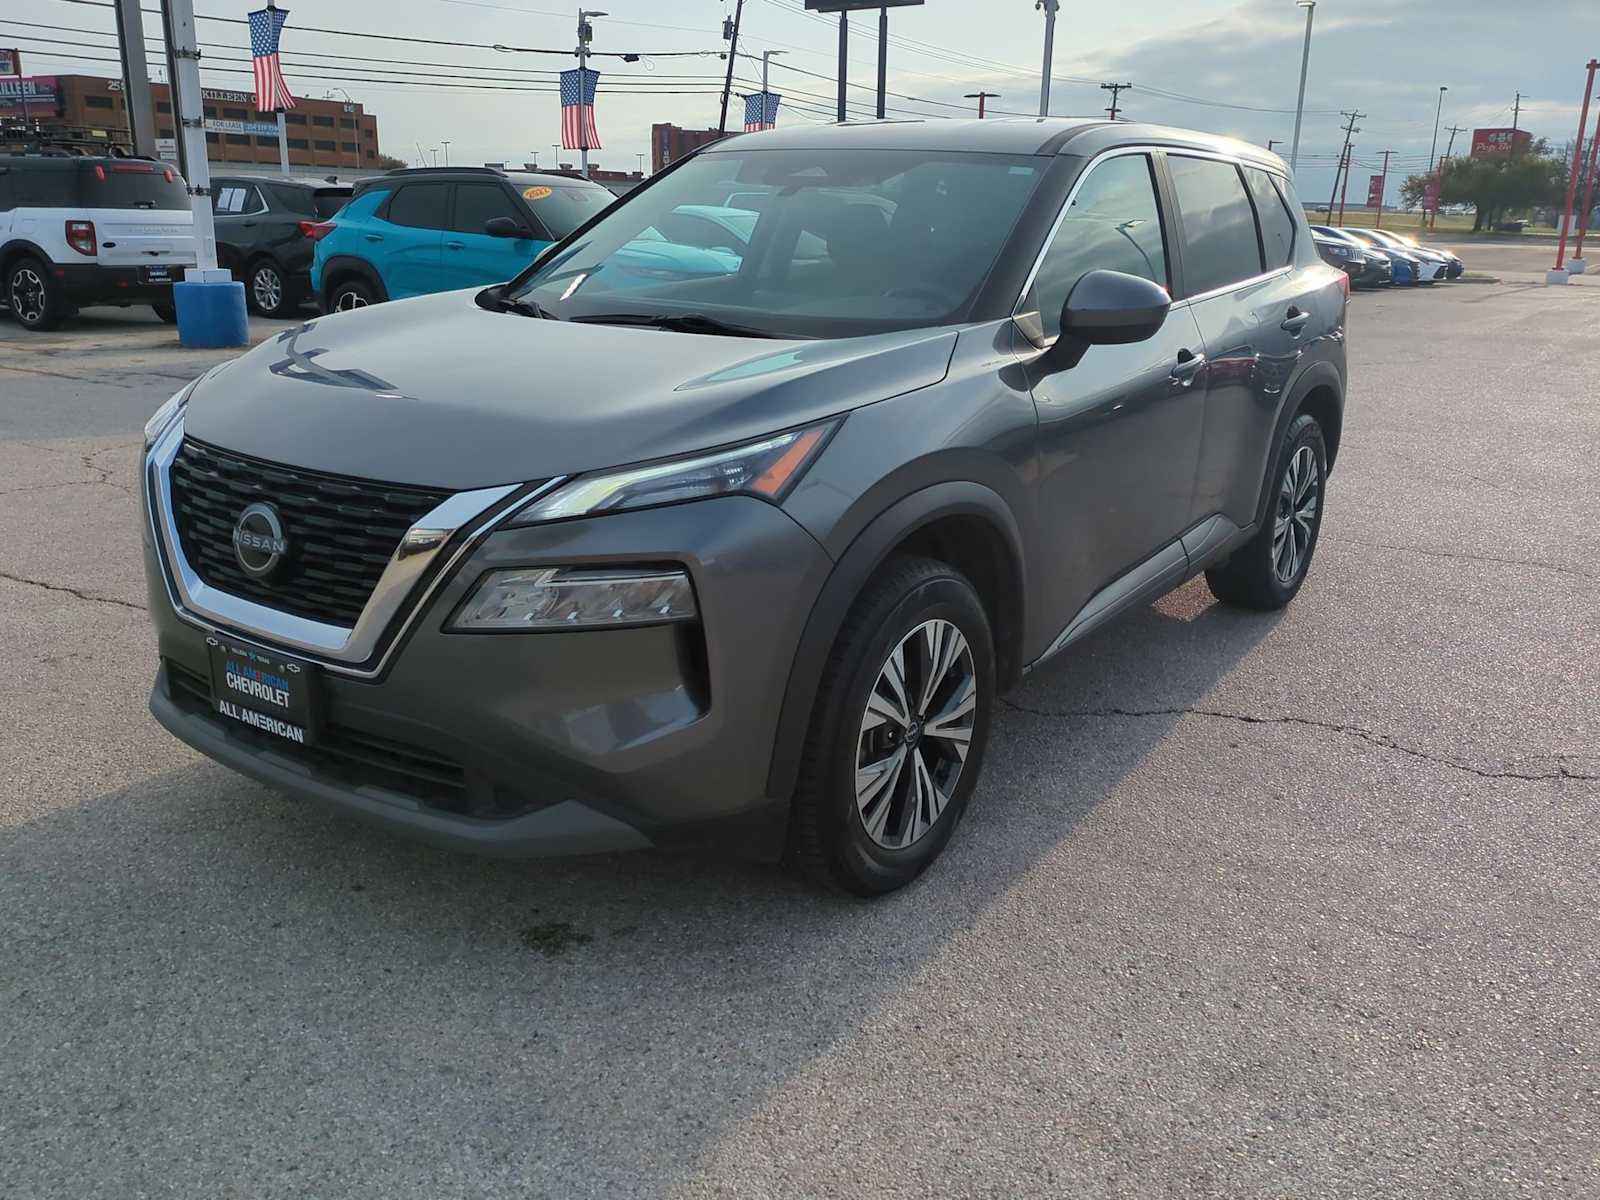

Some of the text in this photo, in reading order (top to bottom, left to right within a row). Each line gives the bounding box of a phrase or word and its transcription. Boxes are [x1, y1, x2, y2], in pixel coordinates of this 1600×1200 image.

[0, 81, 36, 95] ILLEEN
[202, 90, 247, 103] KILLEEN
[233, 526, 285, 553] NISSAN
[226, 671, 290, 708] CHEVROLET
[219, 699, 304, 743] ALL AMERICAN
